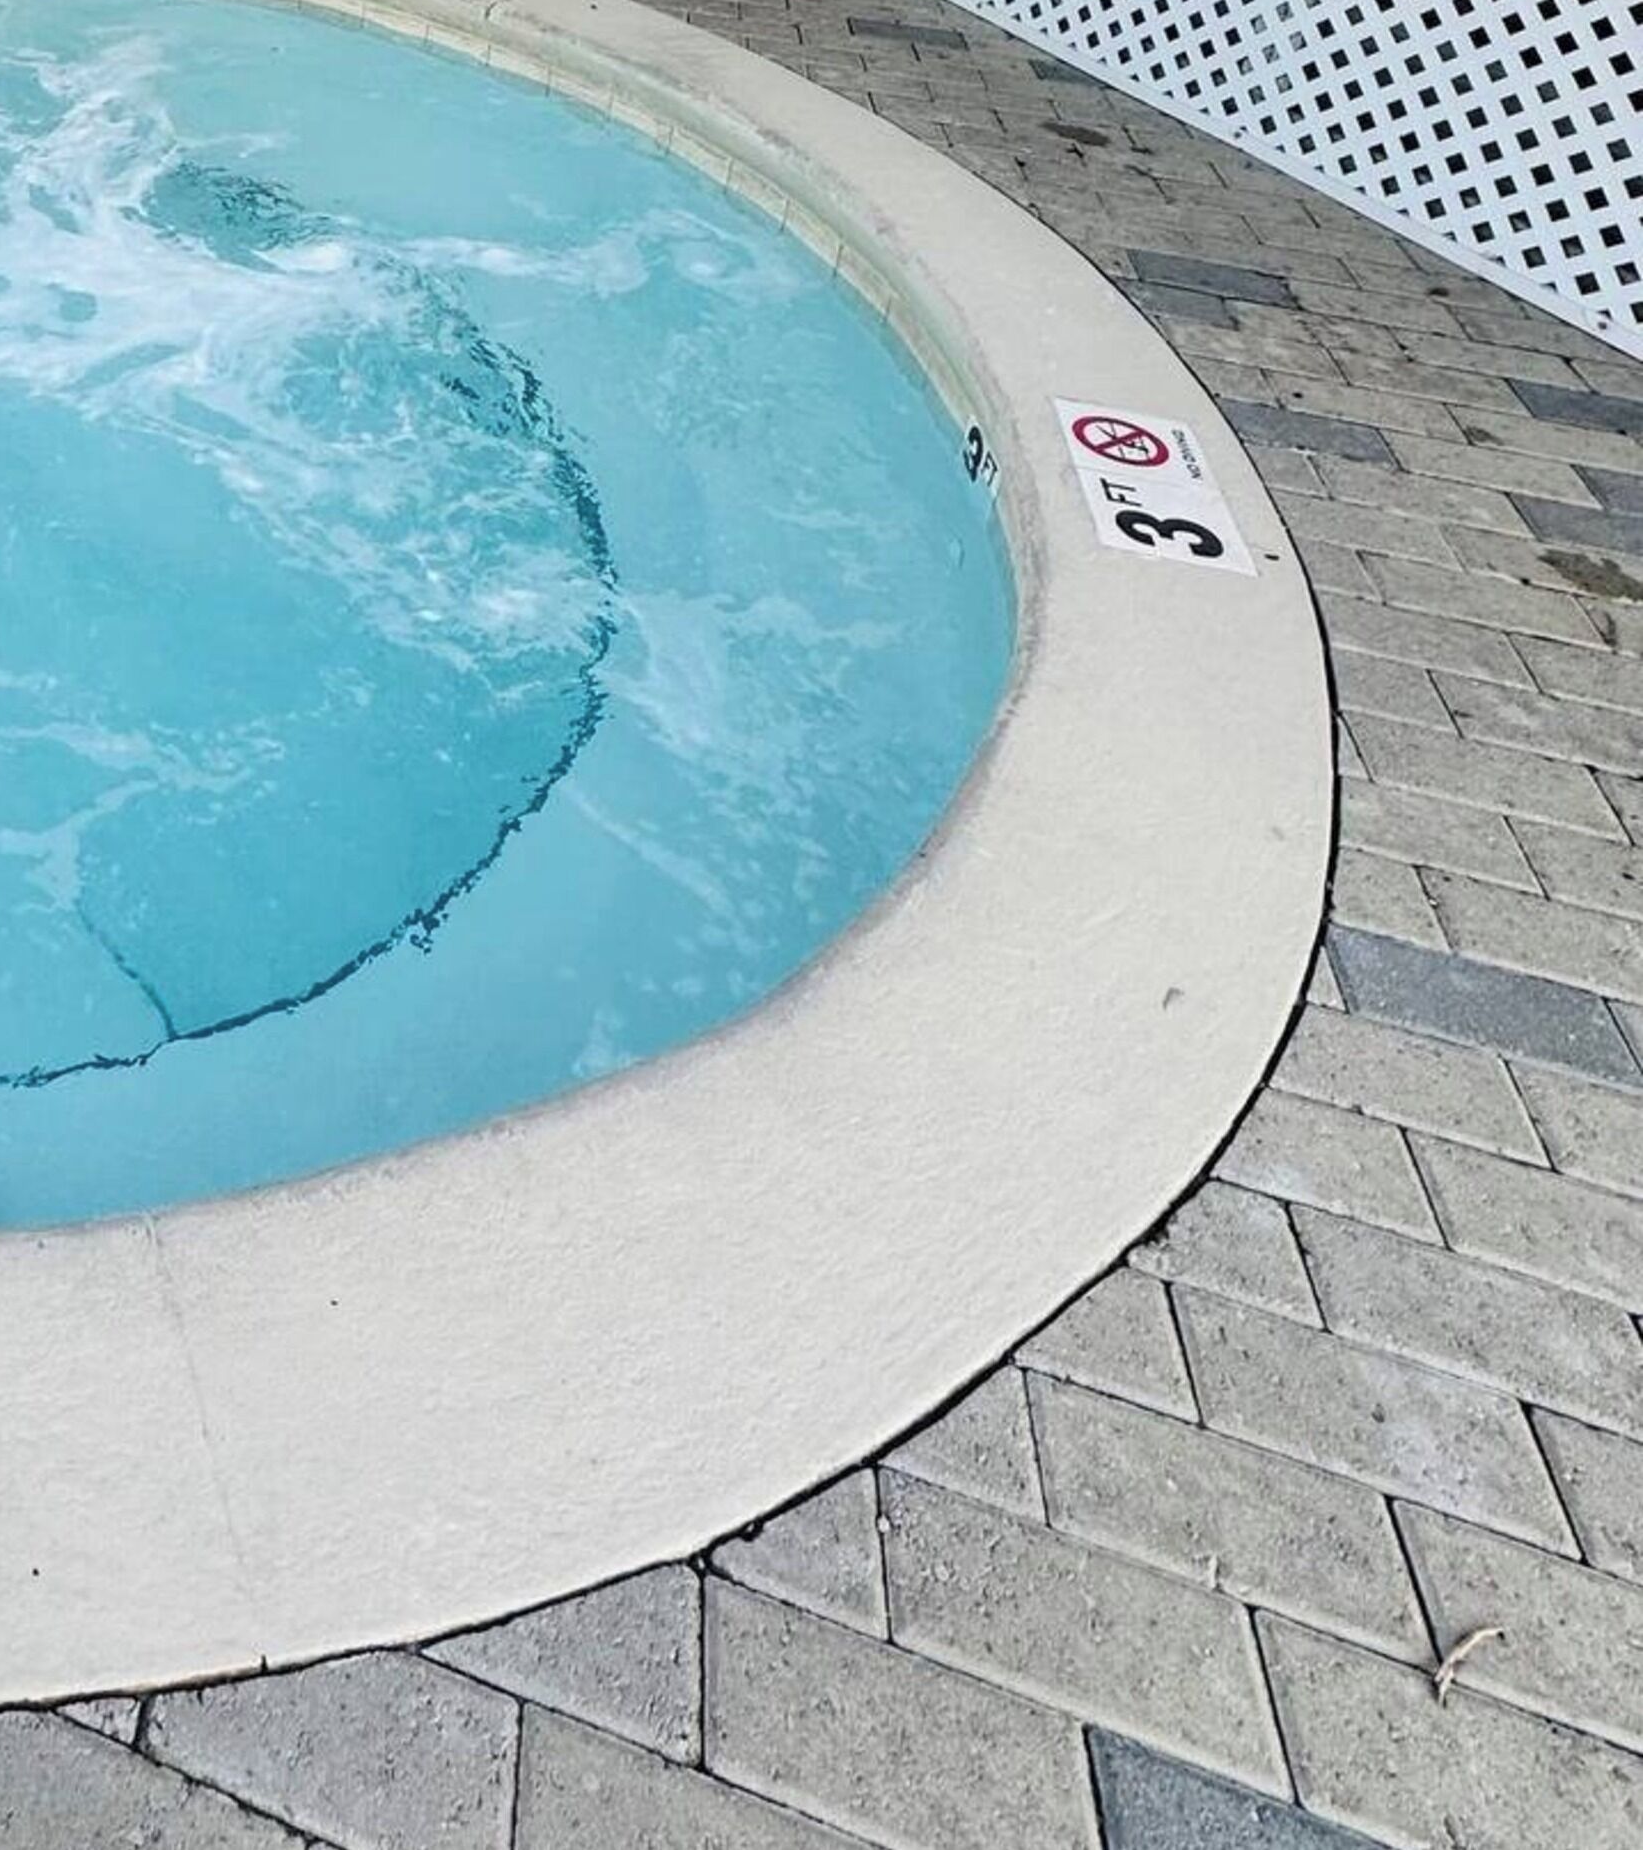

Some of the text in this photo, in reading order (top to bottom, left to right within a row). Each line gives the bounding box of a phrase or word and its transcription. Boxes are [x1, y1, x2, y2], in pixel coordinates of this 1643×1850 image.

[980, 451, 999, 488] FT
[1186, 464, 1204, 482] NO
[1100, 477, 1225, 559] 3 FT
